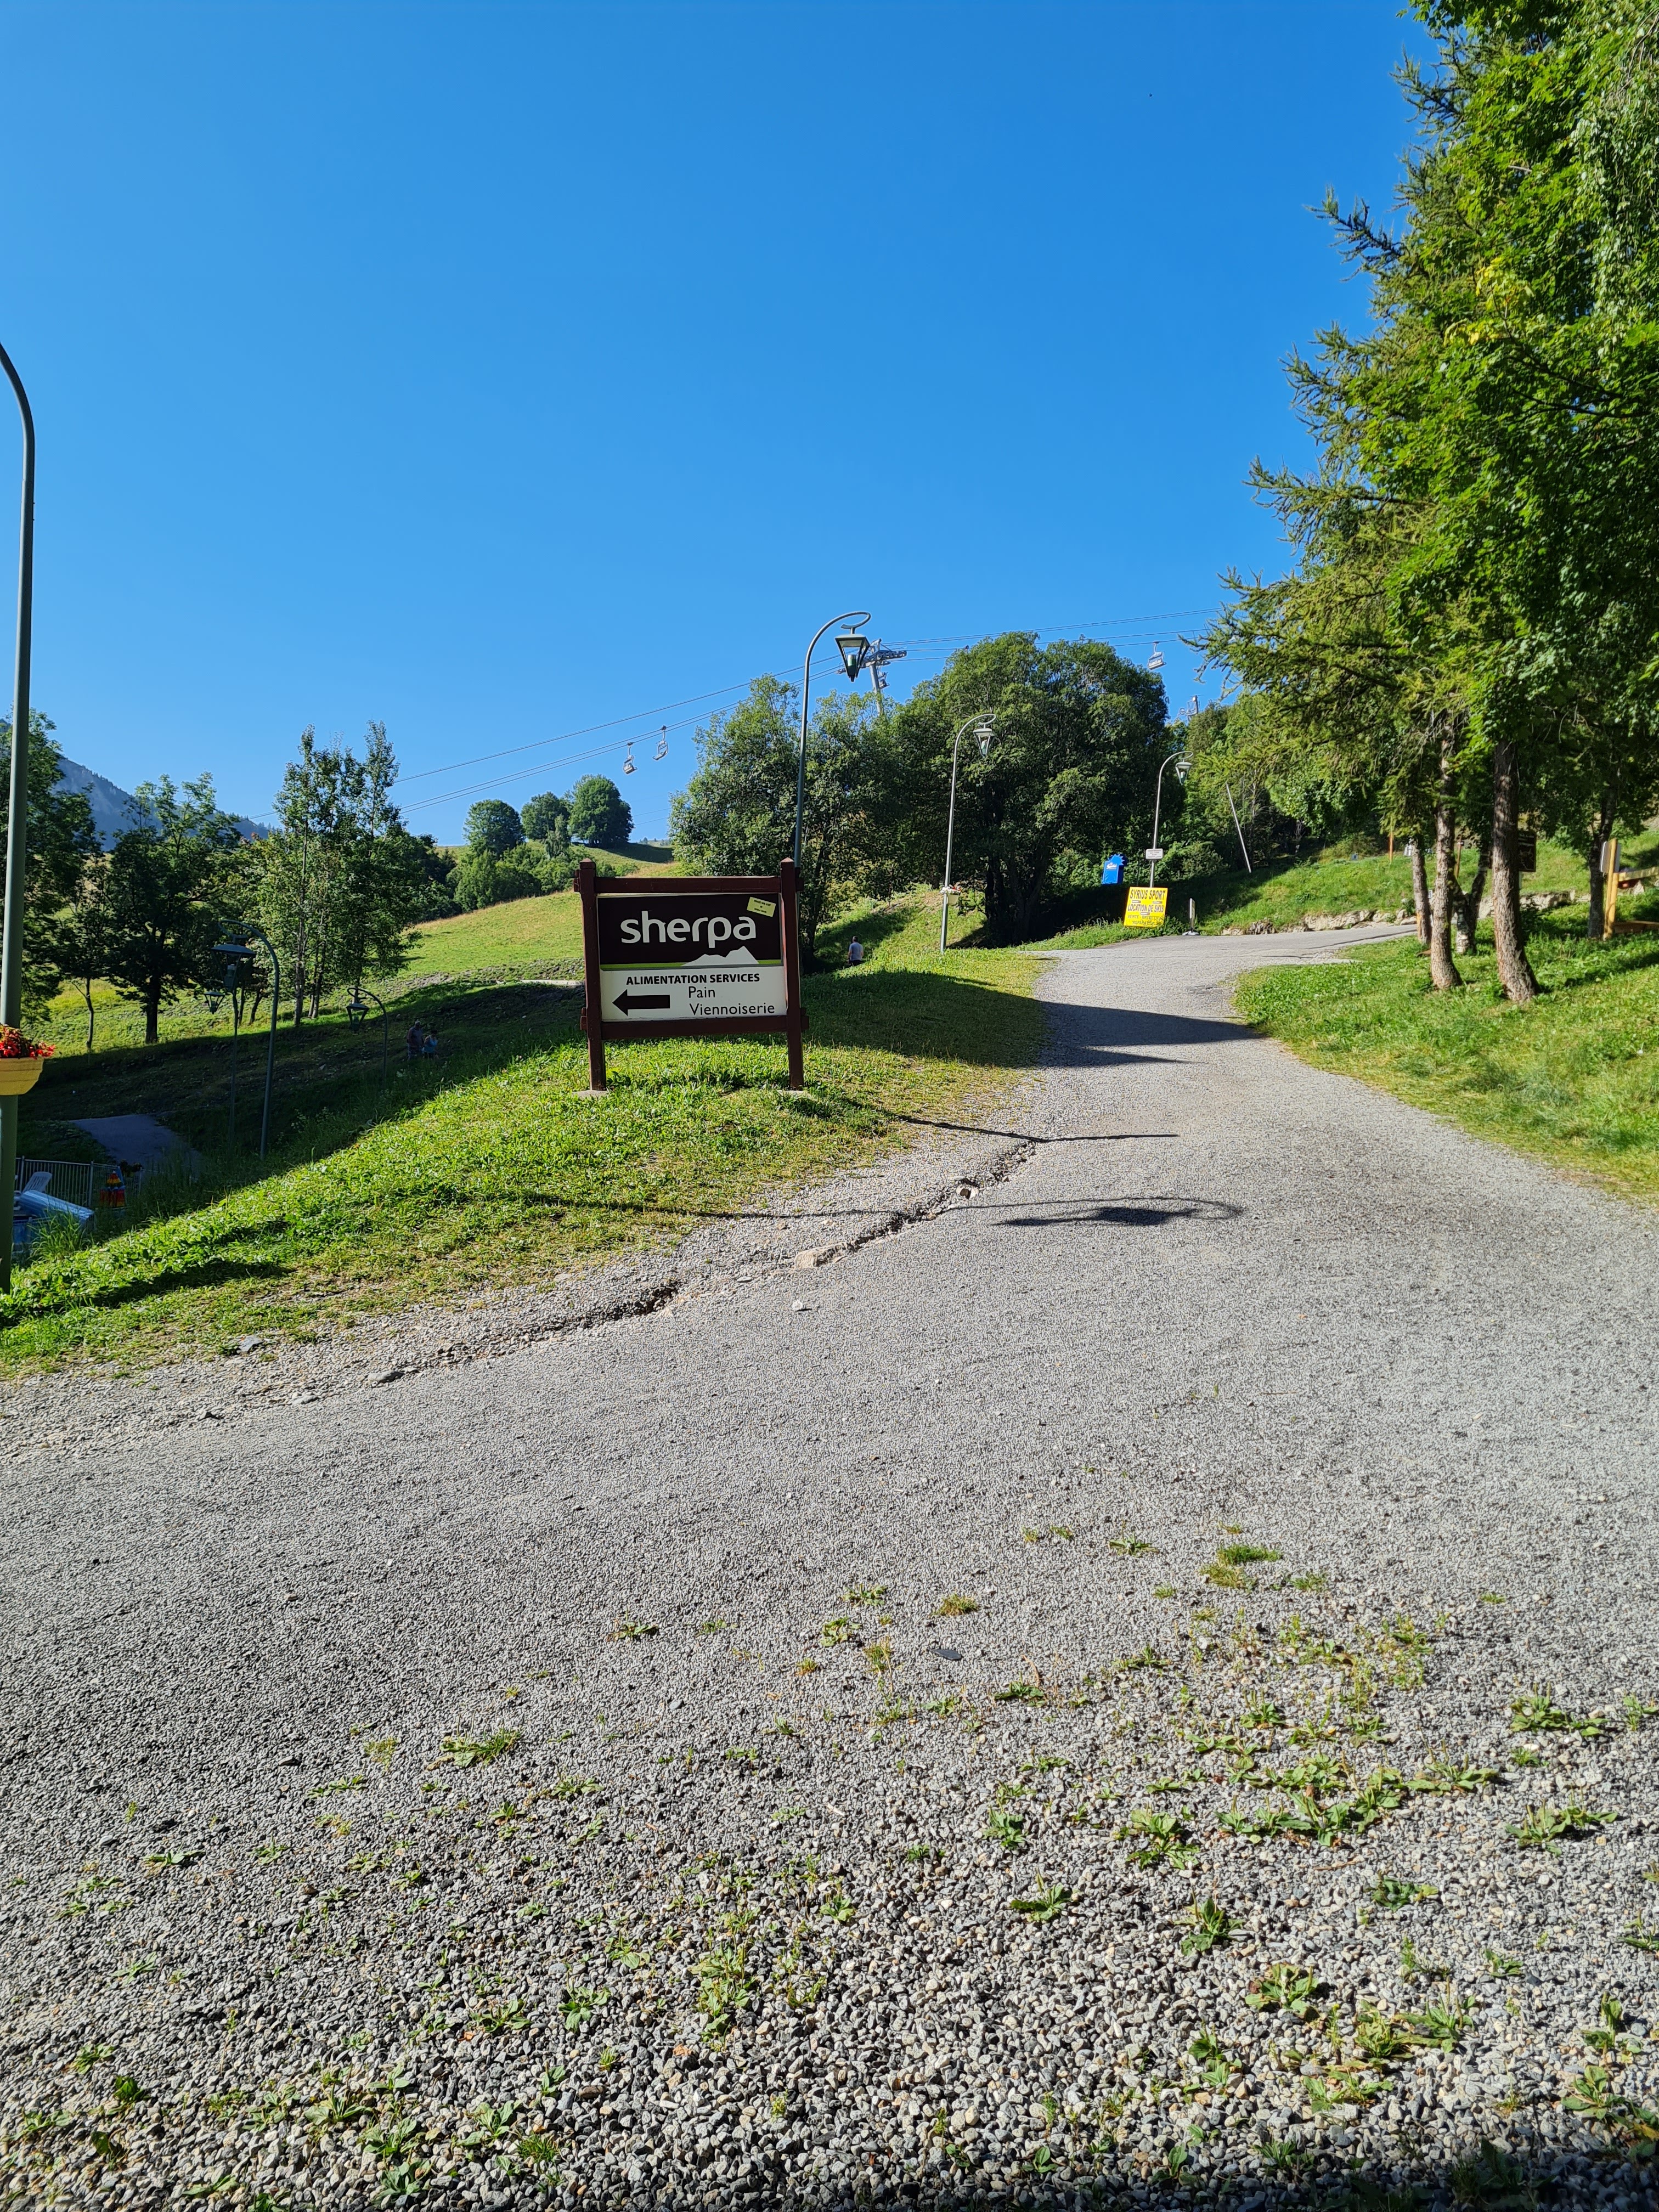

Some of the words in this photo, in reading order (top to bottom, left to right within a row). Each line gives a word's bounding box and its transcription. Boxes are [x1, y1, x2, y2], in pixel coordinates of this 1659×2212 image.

[1130, 889, 1148, 899] SYRIUS
[1149, 890, 1166, 900] SPORT
[620, 911, 756, 948] sherpa
[626, 975, 707, 985] ALIMENTATION
[709, 973, 760, 983] SERVICES
[689, 986, 715, 998] Pain
[690, 1002, 775, 1015] Viennoiserie
